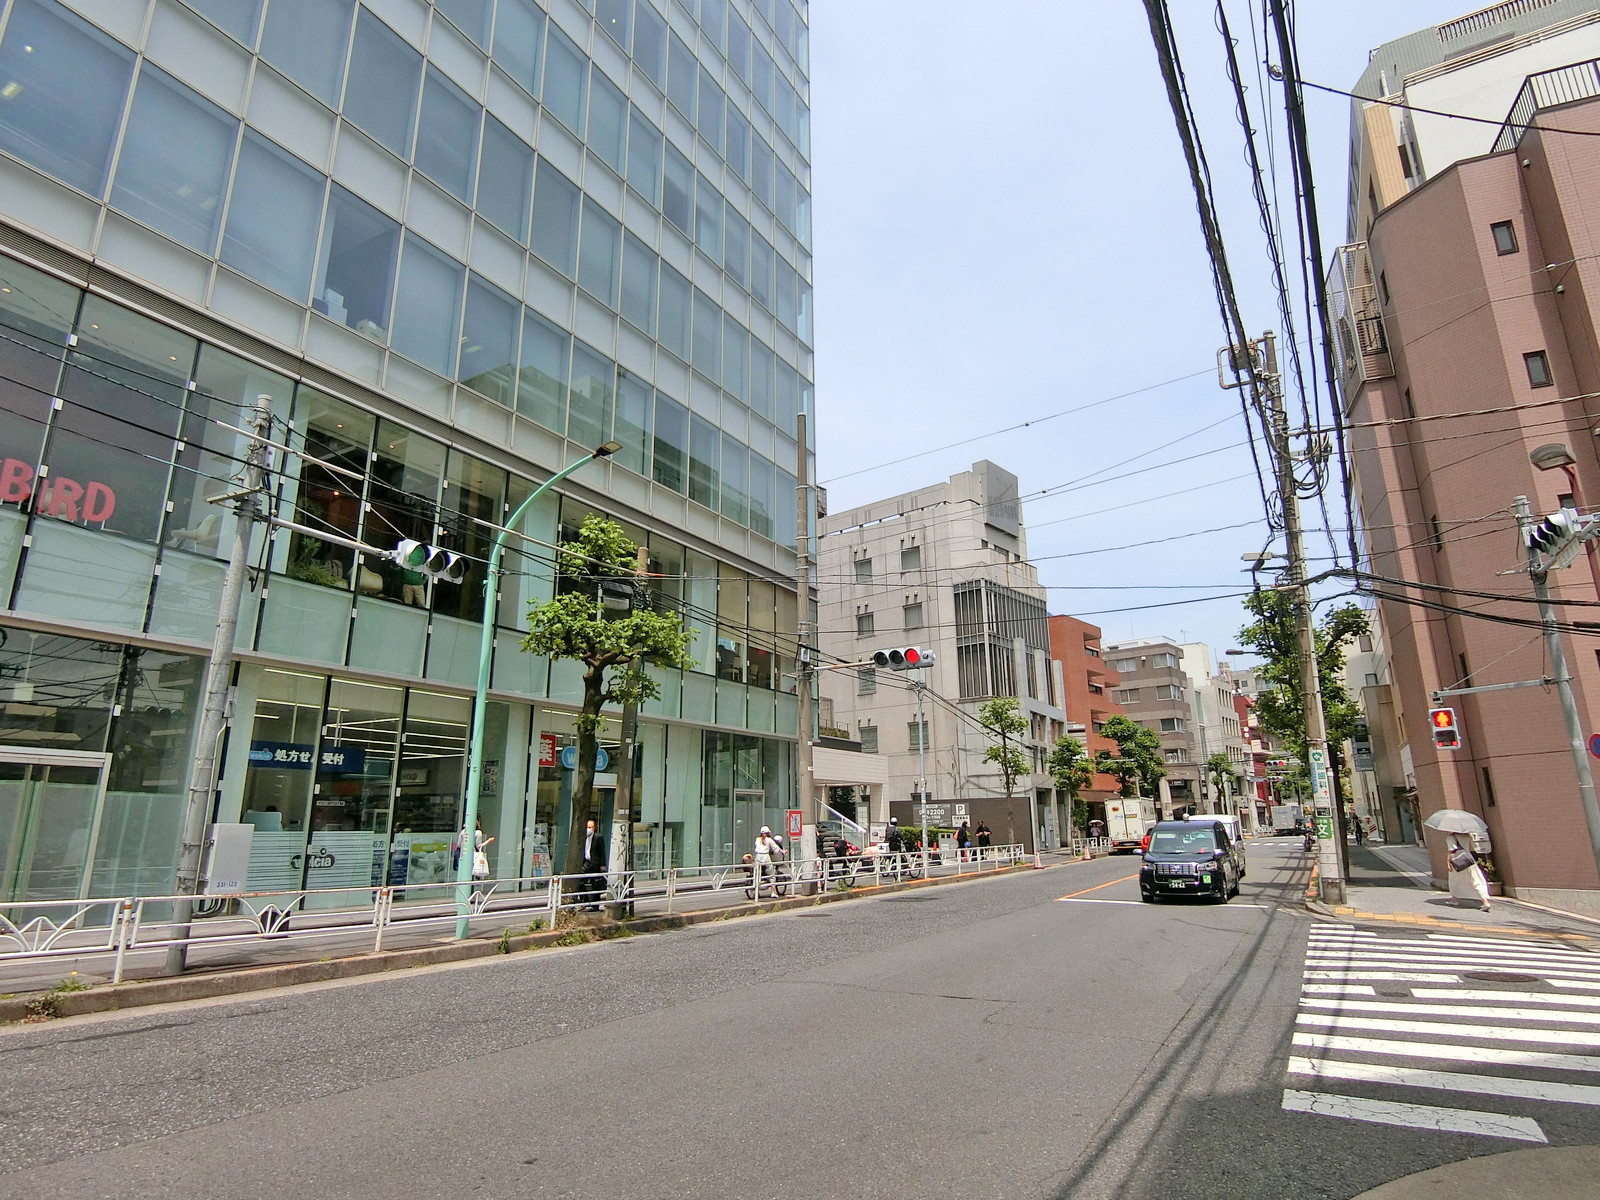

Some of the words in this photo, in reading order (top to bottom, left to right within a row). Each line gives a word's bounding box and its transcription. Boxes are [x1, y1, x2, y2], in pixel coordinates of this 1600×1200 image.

[0, 457, 116, 522] BIRD
[274, 749, 345, 765] 処方せ受付
[292, 850, 332, 868] wlcia
